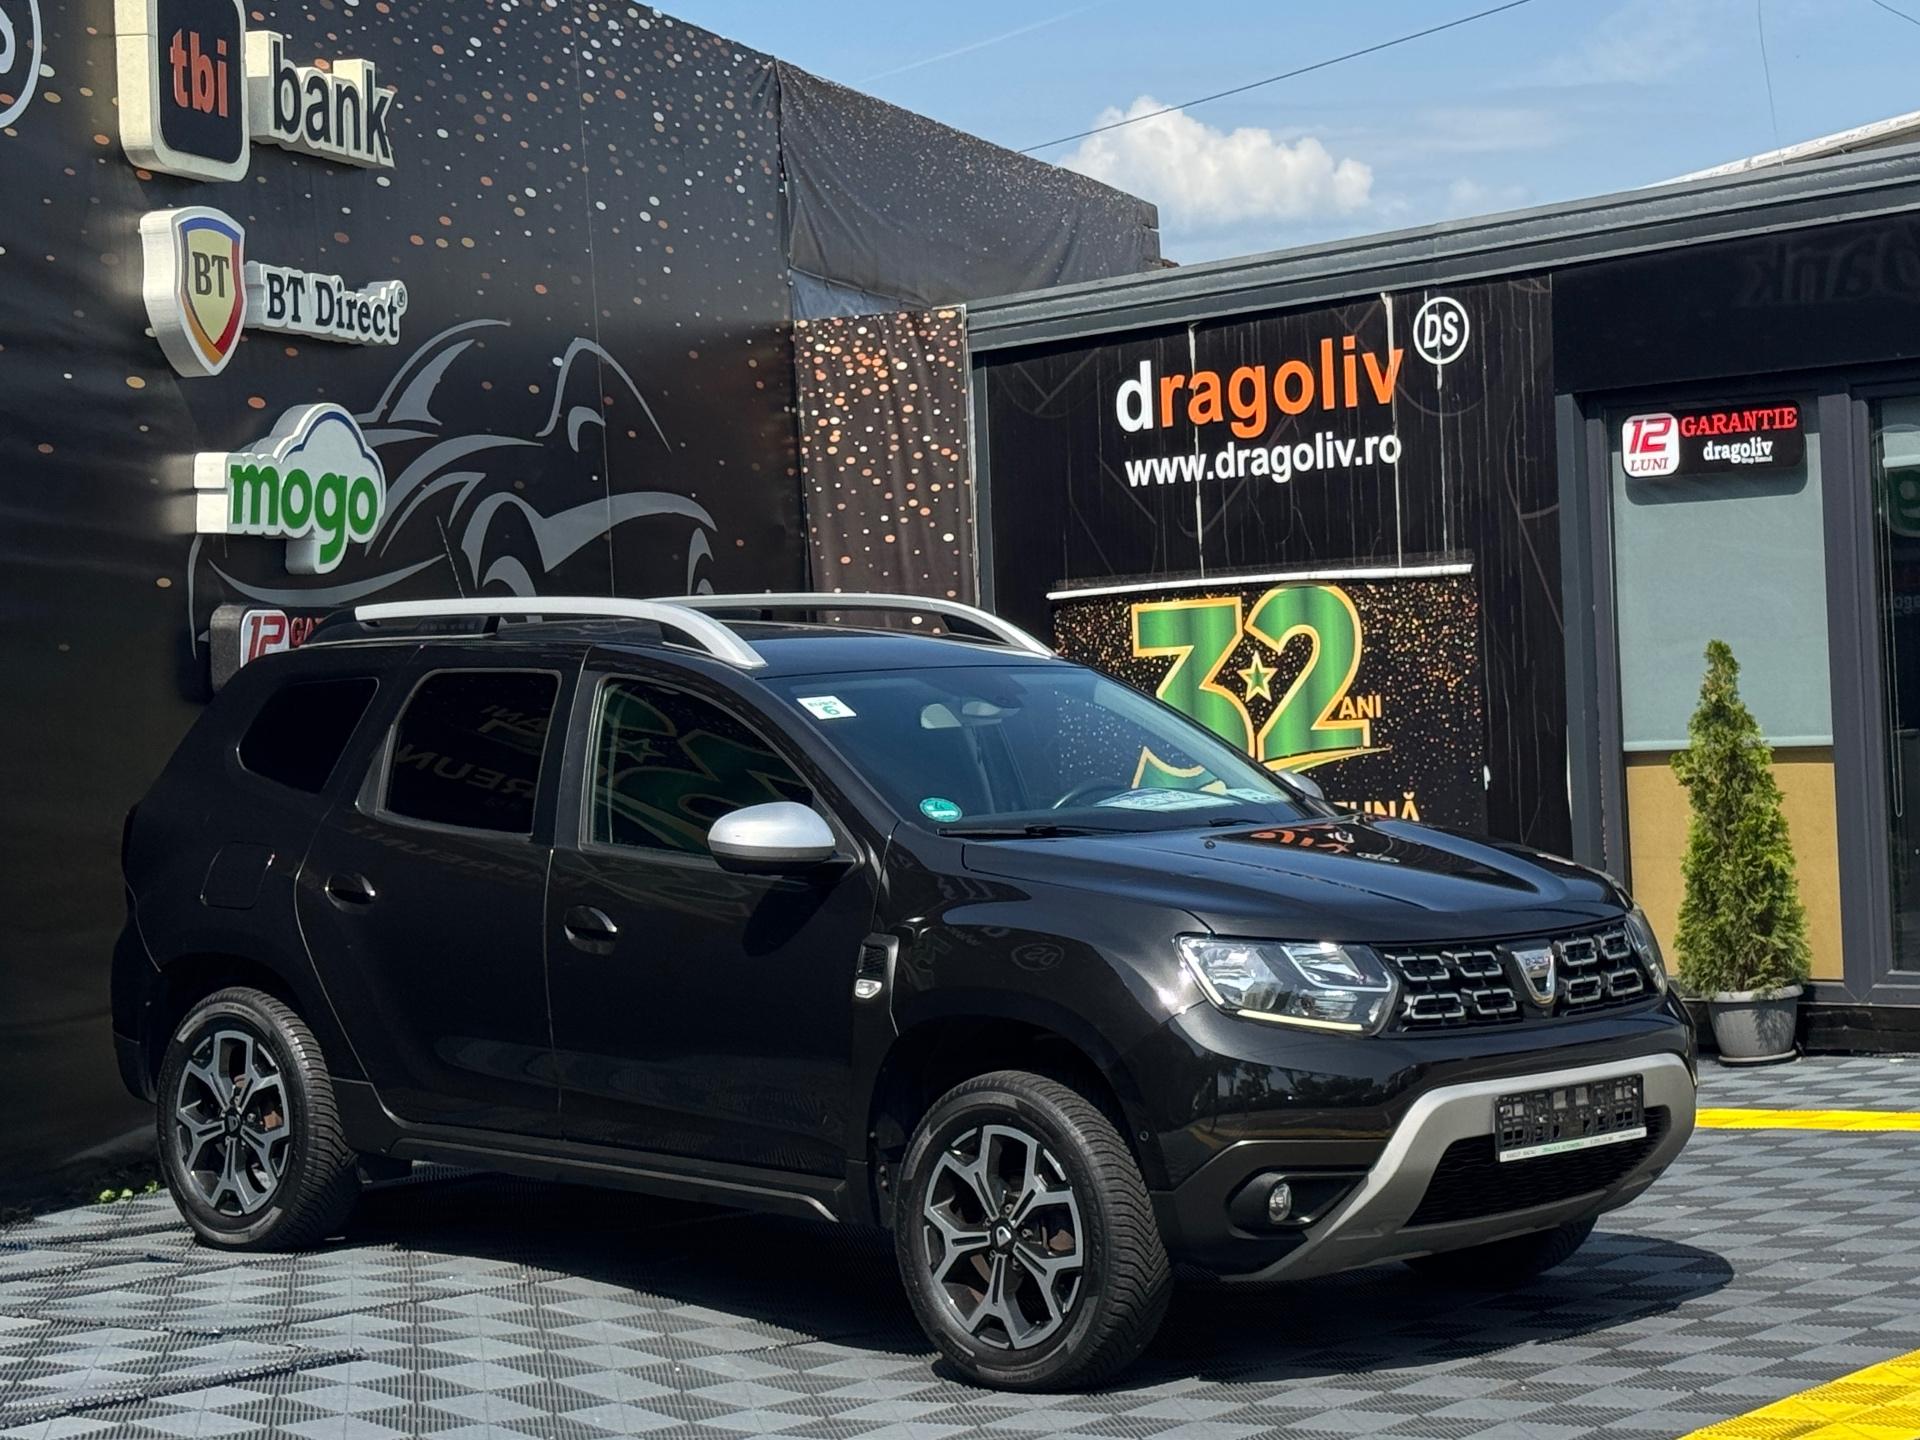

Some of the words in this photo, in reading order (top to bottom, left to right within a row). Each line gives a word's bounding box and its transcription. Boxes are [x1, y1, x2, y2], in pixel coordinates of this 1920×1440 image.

[169, 29, 229, 118] tbi
[272, 40, 394, 162] bank
[192, 251, 230, 298] BT
[266, 273, 306, 323] BT
[1423, 312, 1460, 350] DS
[1115, 334, 1404, 438] dragoliv
[1629, 416, 1672, 454] 12
[1680, 407, 1798, 438] GARANTIE
[1703, 436, 1774, 464] dragoliv
[1124, 430, 1402, 488] www.dragoliv.ro
[1630, 457, 1670, 473] LUNI
[229, 463, 378, 565] mogo
[290, 616, 326, 648] GA
[1131, 580, 1372, 763] 32
[1338, 694, 1382, 720] ANI
